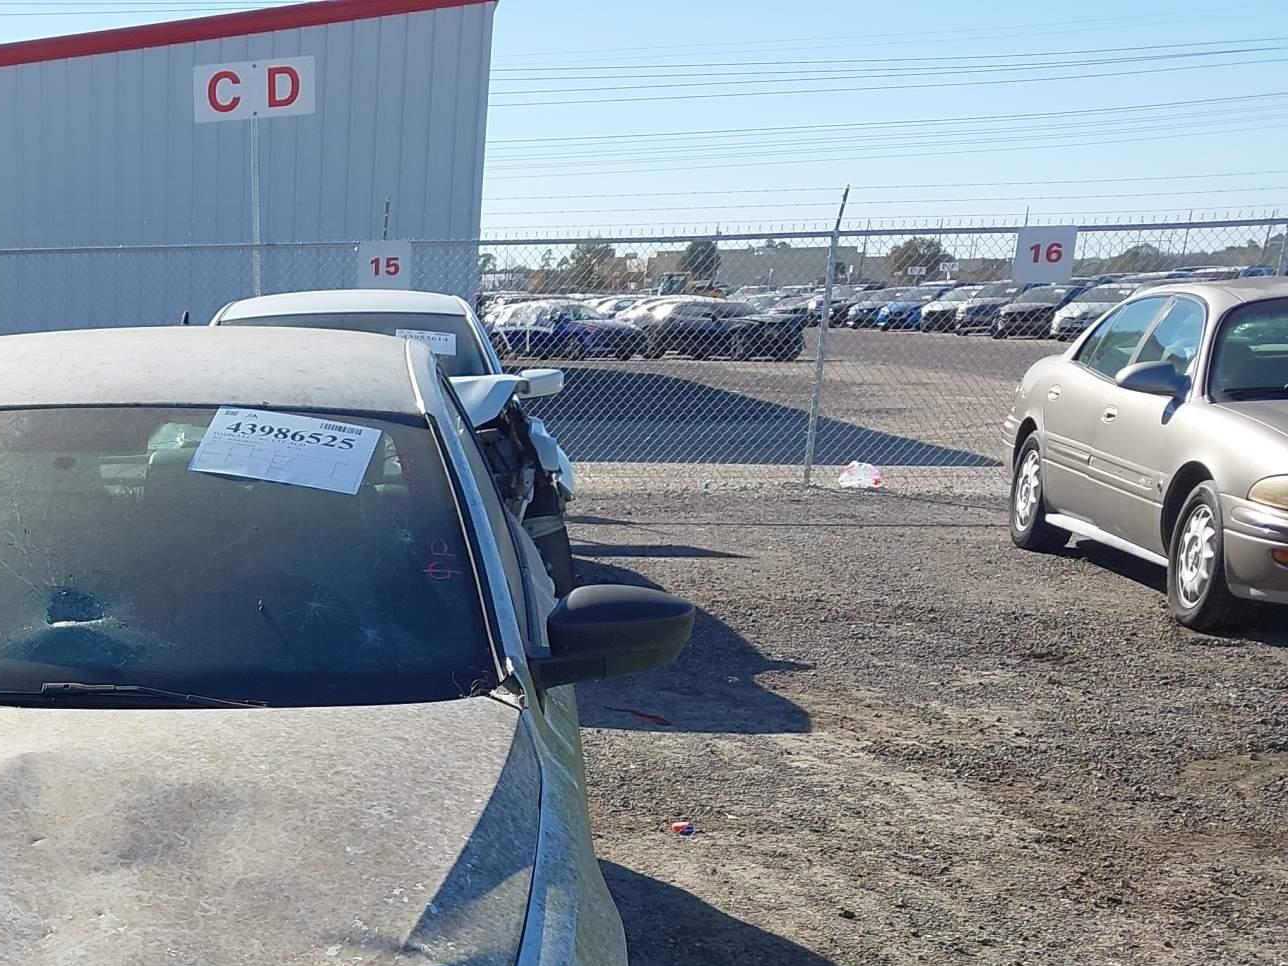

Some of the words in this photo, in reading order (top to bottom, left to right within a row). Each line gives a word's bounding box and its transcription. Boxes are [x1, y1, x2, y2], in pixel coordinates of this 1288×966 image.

[208, 71, 241, 112] C
[268, 66, 300, 108] D
[370, 256, 400, 276] 15
[1030, 243, 1063, 264] 16
[226, 421, 356, 450] 43986525
